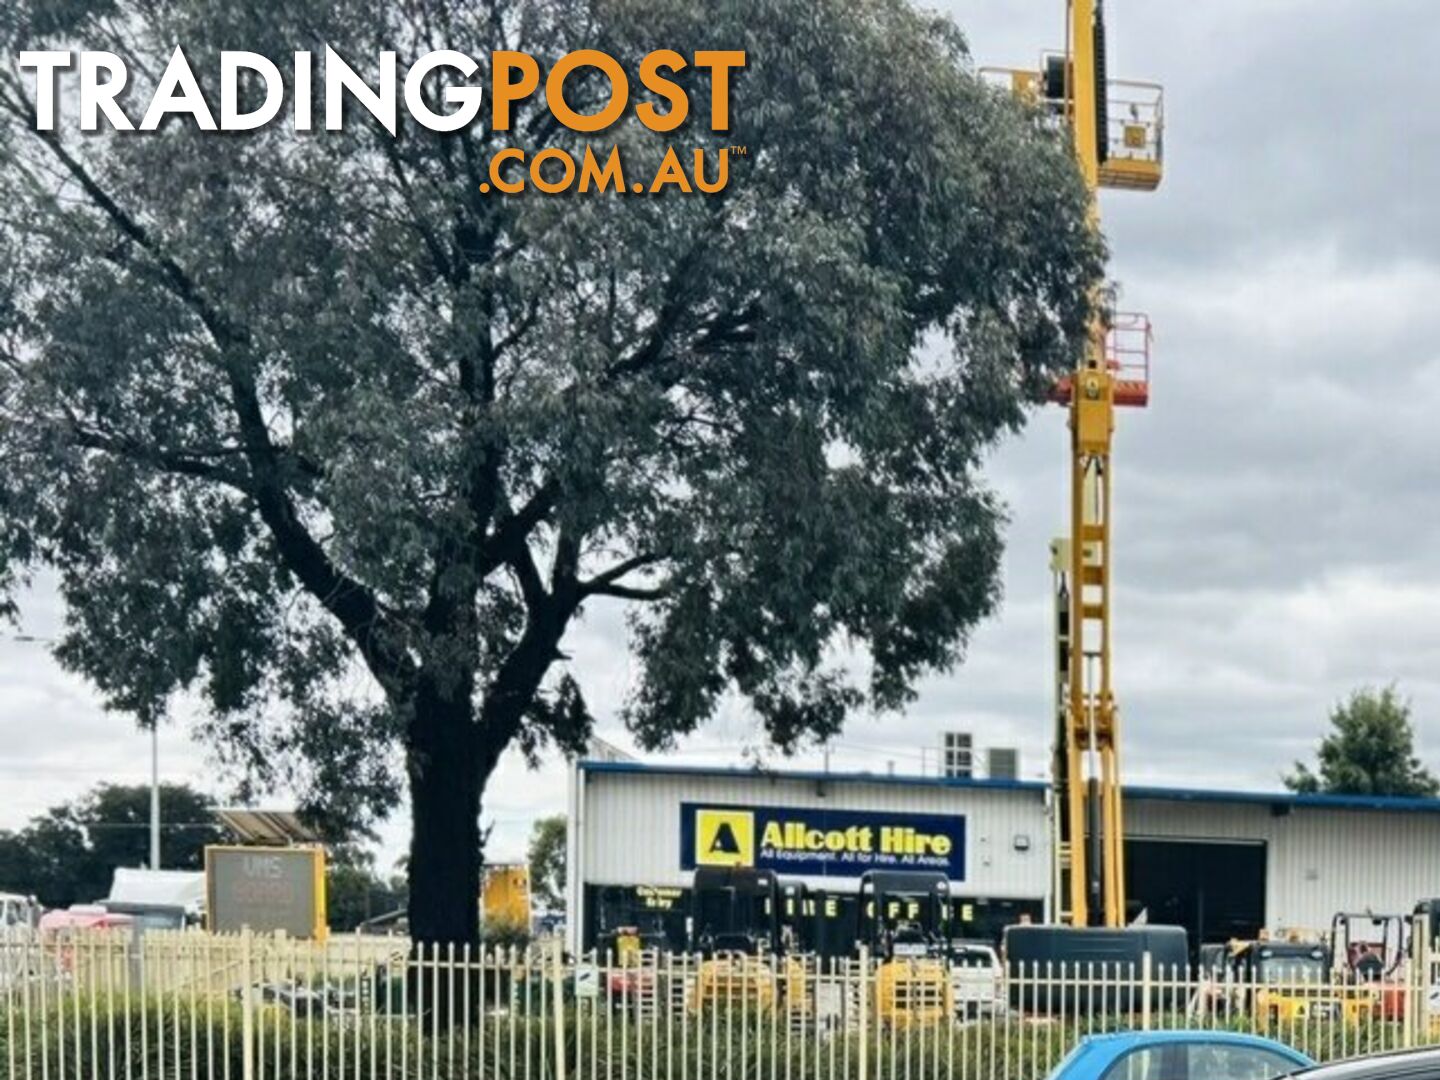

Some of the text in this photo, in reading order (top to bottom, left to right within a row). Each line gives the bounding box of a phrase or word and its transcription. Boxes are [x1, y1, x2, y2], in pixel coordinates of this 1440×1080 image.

[761, 821, 952, 856] Allcott Hire
[841, 853, 855, 862] All
[902, 855, 915, 865] All
